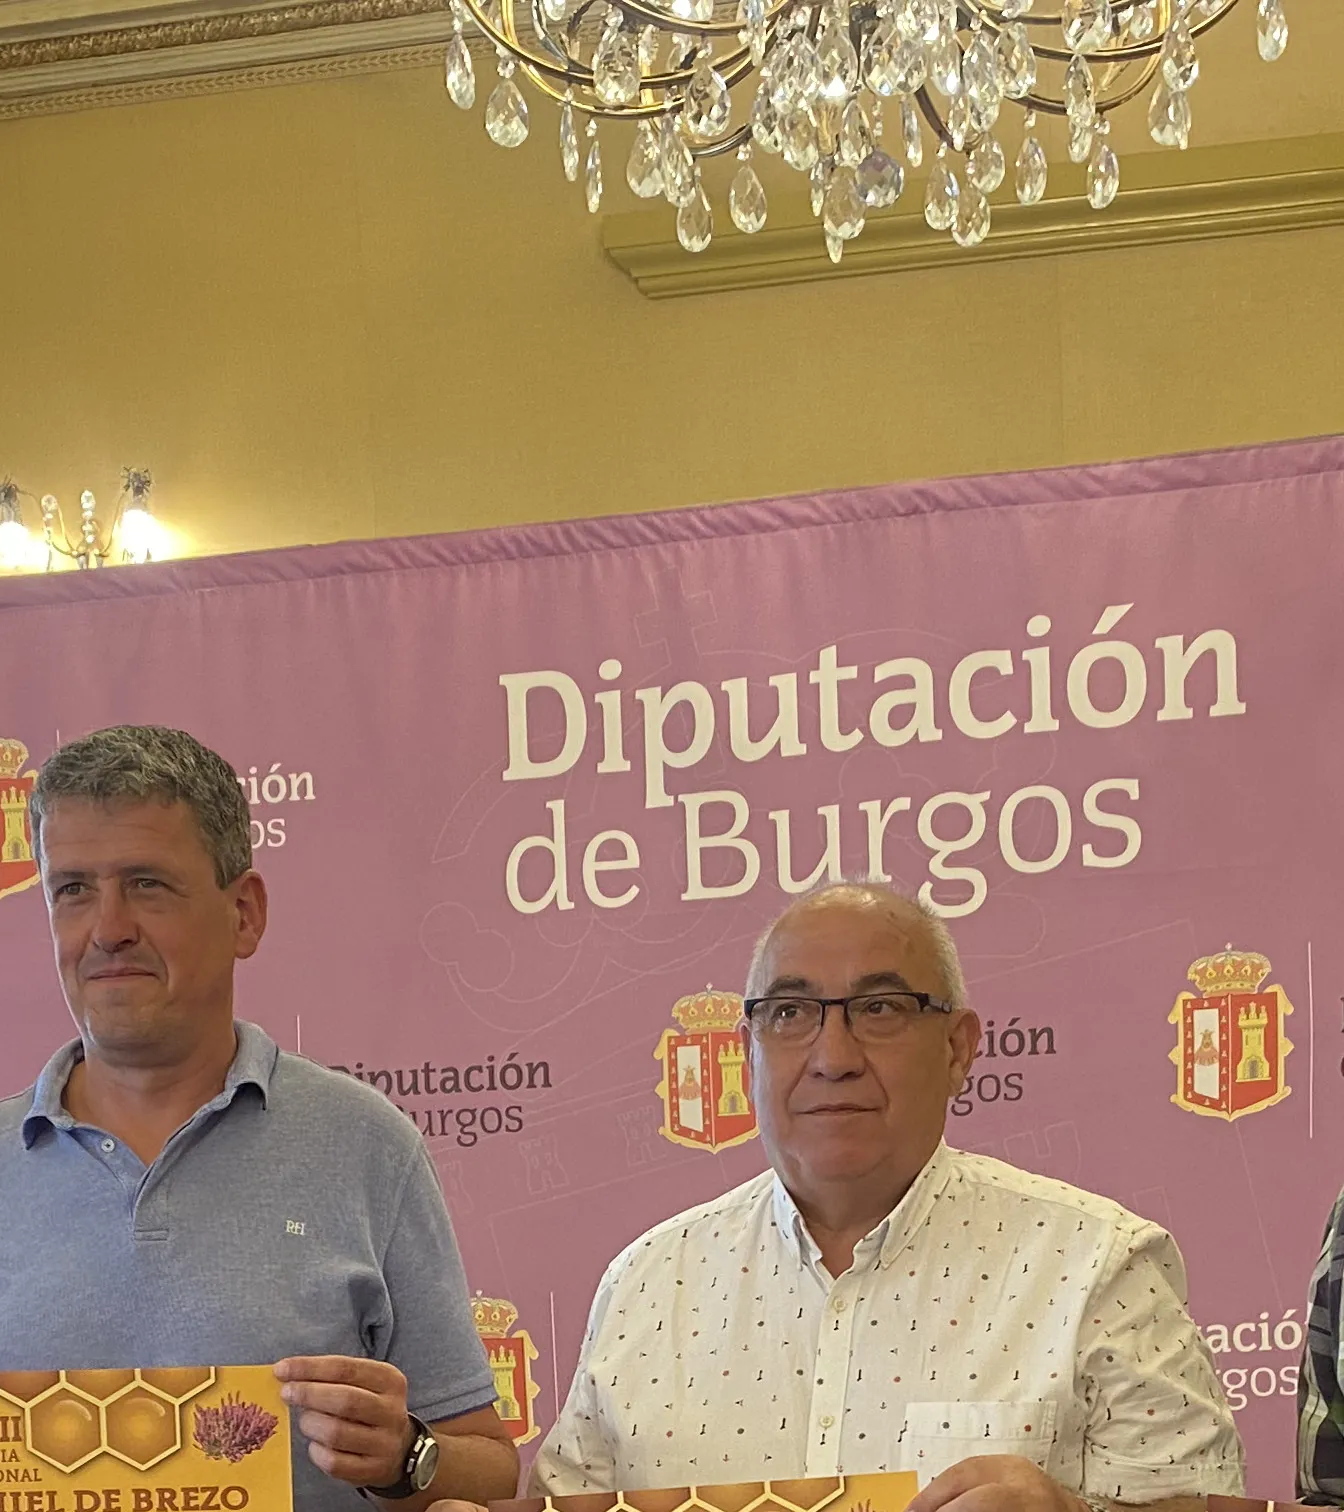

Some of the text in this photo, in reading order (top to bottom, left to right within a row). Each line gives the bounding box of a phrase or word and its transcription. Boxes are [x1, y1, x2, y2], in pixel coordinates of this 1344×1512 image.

[499, 603, 1246, 808] Diputación
[505, 778, 1143, 918] de Burgos
[398, 1105, 524, 1148] urgos
[131, 1486, 249, 1512] BREZO
